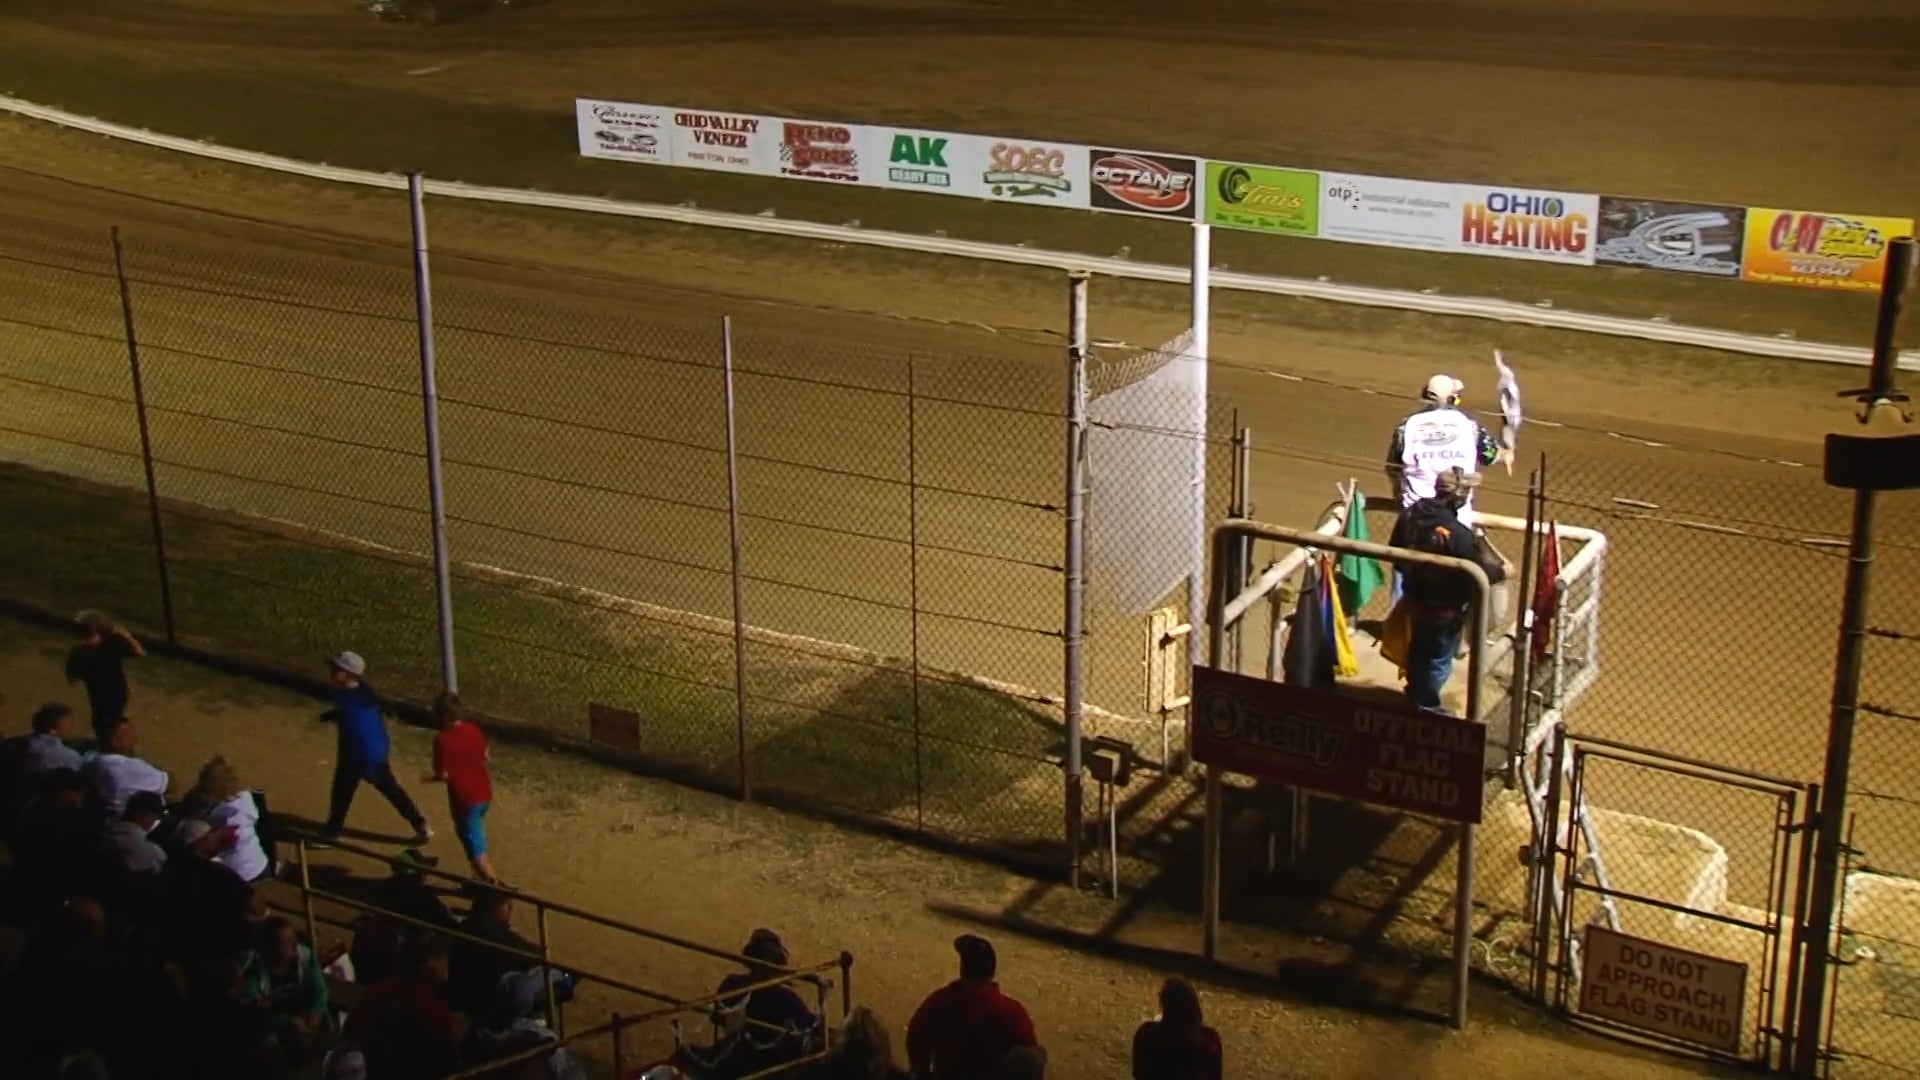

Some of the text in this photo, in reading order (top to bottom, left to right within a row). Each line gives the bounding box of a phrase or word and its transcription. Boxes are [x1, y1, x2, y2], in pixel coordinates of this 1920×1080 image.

[675, 113, 708, 128] OHIO
[708, 115, 759, 134] VALLEY
[693, 130, 748, 148] VENEER
[890, 134, 949, 168] AK
[1092, 165, 1194, 192] OCTANE
[1328, 187, 1352, 202] otp
[1486, 192, 1564, 218] OHIO
[1461, 202, 1589, 253] HEATING
[1201, 688, 1342, 771] O'Reilly
[1353, 706, 1479, 755] OFFICIAL
[1379, 743, 1450, 778] FLAG
[1366, 768, 1460, 807] STAND
[1619, 945, 1708, 983] DO NOT
[1597, 963, 1727, 1013] APPROACH
[1589, 983, 1732, 1040] FLAG STAND
